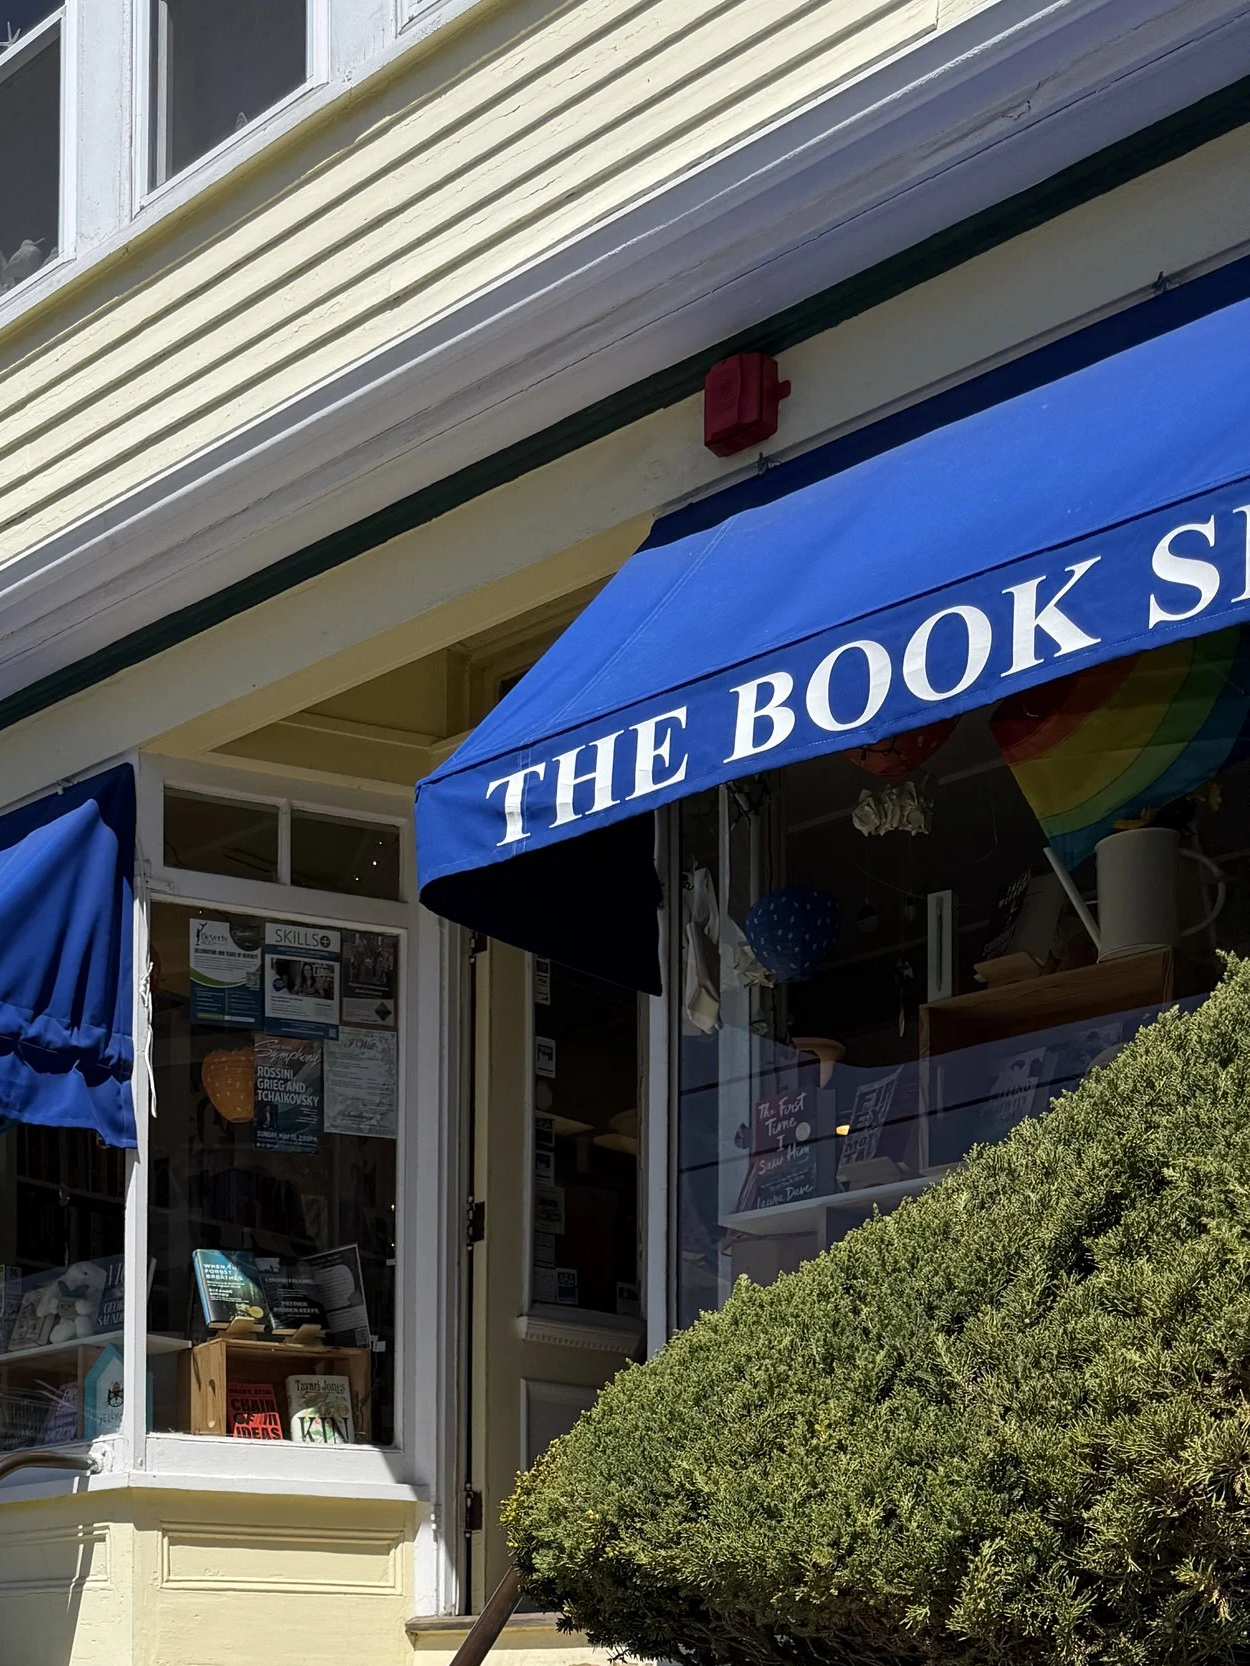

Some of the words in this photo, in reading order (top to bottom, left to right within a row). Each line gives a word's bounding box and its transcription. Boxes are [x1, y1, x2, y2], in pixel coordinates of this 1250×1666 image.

[486, 705, 688, 847] THE
[723, 556, 1101, 764] BOOK
[1147, 504, 1250, 629] S
[254, 1040, 321, 1066] Symphony
[257, 1078, 284, 1090] GRIEG
[286, 1081, 306, 1093] AND
[256, 1090, 319, 1107] TCHAIKOVSKY
[758, 1102, 775, 1119] The
[779, 1092, 806, 1116] First
[765, 1117, 797, 1136] Time
[777, 1134, 784, 1151] I
[758, 1156, 783, 1175] Saw
[787, 1142, 810, 1161] Him
[785, 1184, 814, 1202] Dave
[231, 1398, 276, 1413] CHAIN
[235, 1426, 281, 1440] IDEAS
[298, 1417, 350, 1443] KIN
